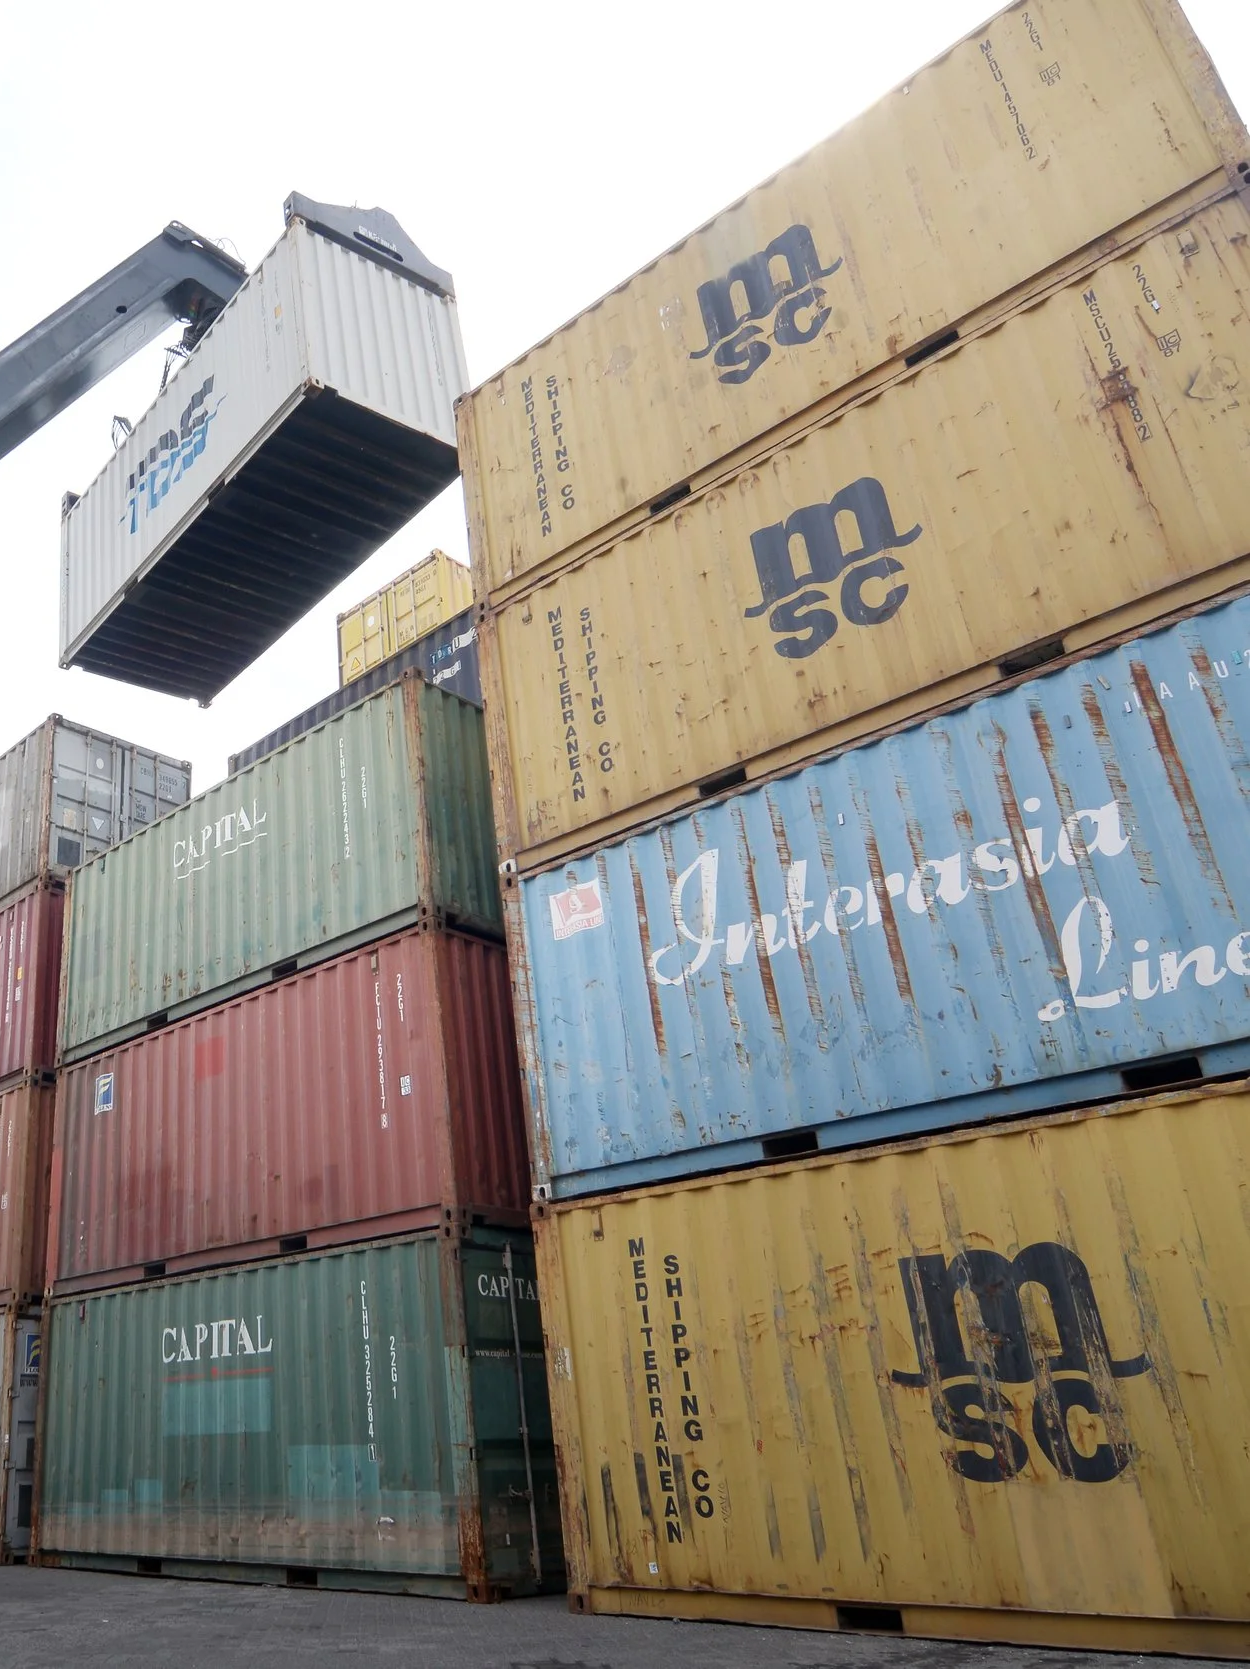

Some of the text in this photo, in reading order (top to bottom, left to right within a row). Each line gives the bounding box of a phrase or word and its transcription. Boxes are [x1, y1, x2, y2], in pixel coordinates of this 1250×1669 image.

[521, 375, 552, 537] MEDITERRANEAN
[545, 375, 575, 510] SHIPPING CO
[547, 606, 586, 802] MEDITERRANEAN
[579, 607, 613, 772] SHIPPING CO
[174, 798, 267, 868] CAPITAL
[651, 797, 1132, 986] Interasia
[396, 973, 404, 1022] 22G1
[162, 1315, 273, 1364] CAPITAL
[360, 1281, 369, 1339] CLHU
[365, 1345, 374, 1438] 325284
[478, 1274, 540, 1301] CAPTA
[628, 1237, 683, 1544] MEDITERRANEAN
[663, 1254, 714, 1519] SHIPPING CO
